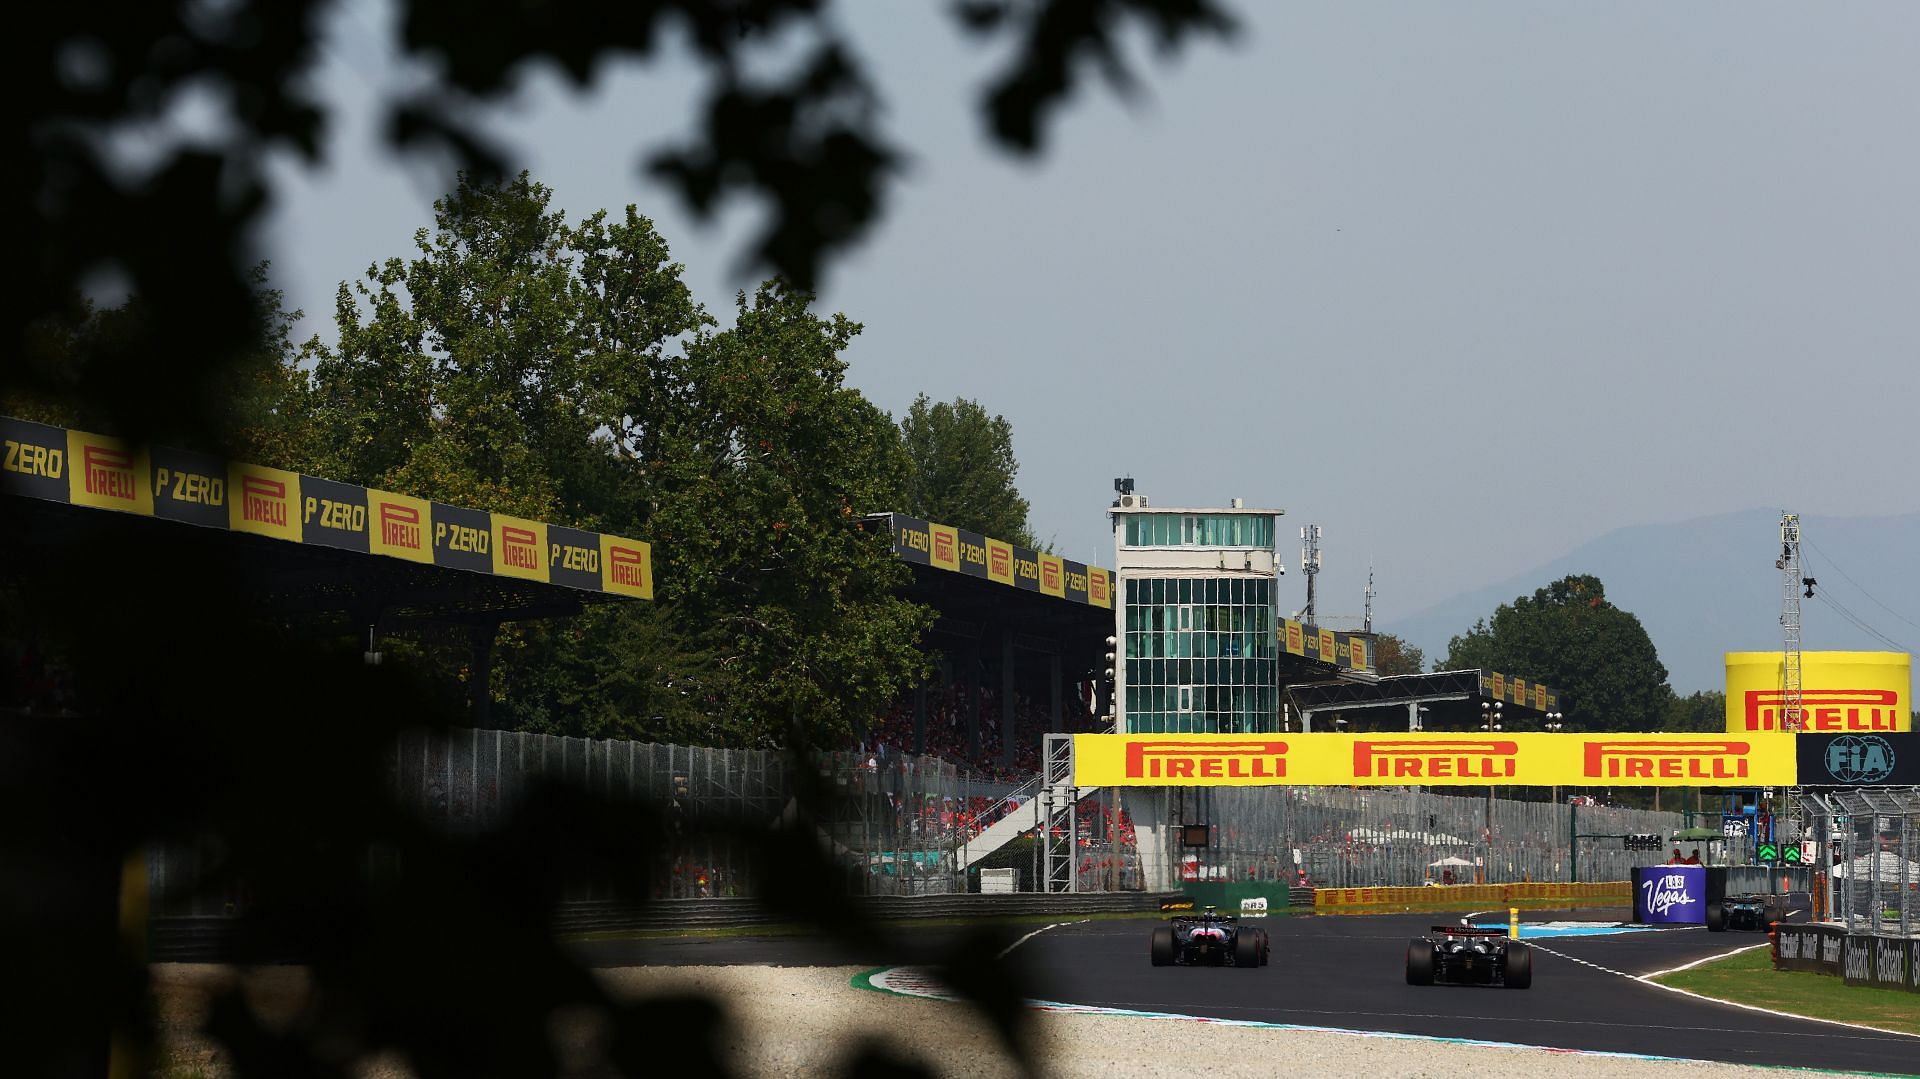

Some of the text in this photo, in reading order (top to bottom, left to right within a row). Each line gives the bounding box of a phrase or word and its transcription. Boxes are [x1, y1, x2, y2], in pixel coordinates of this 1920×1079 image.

[3, 440, 63, 479] ZERO
[84, 445, 136, 500] PIRELLI
[156, 467, 224, 506] P ZERO
[242, 475, 287, 528] PIRELLI
[304, 497, 366, 532] P ZERO
[380, 502, 420, 550] PIRELLI
[435, 522, 489, 554] P ZERO
[502, 526, 538, 570] PIRELLI
[901, 527, 928, 552] P ZERO
[935, 531, 954, 564] PIRELLI
[960, 542, 985, 565] P ZERO
[551, 543, 598, 573] P ZERO
[610, 546, 643, 588] PIRELLI
[1020, 560, 1038, 580] ZERO
[1745, 689, 1898, 731] PIRELLI
[1125, 741, 1289, 778] PIRELLI
[1353, 740, 1519, 778] PIRELLI
[1584, 741, 1751, 778] PIRELLI
[1643, 877, 1696, 916] Vegas
[1876, 938, 1904, 984] Globant
